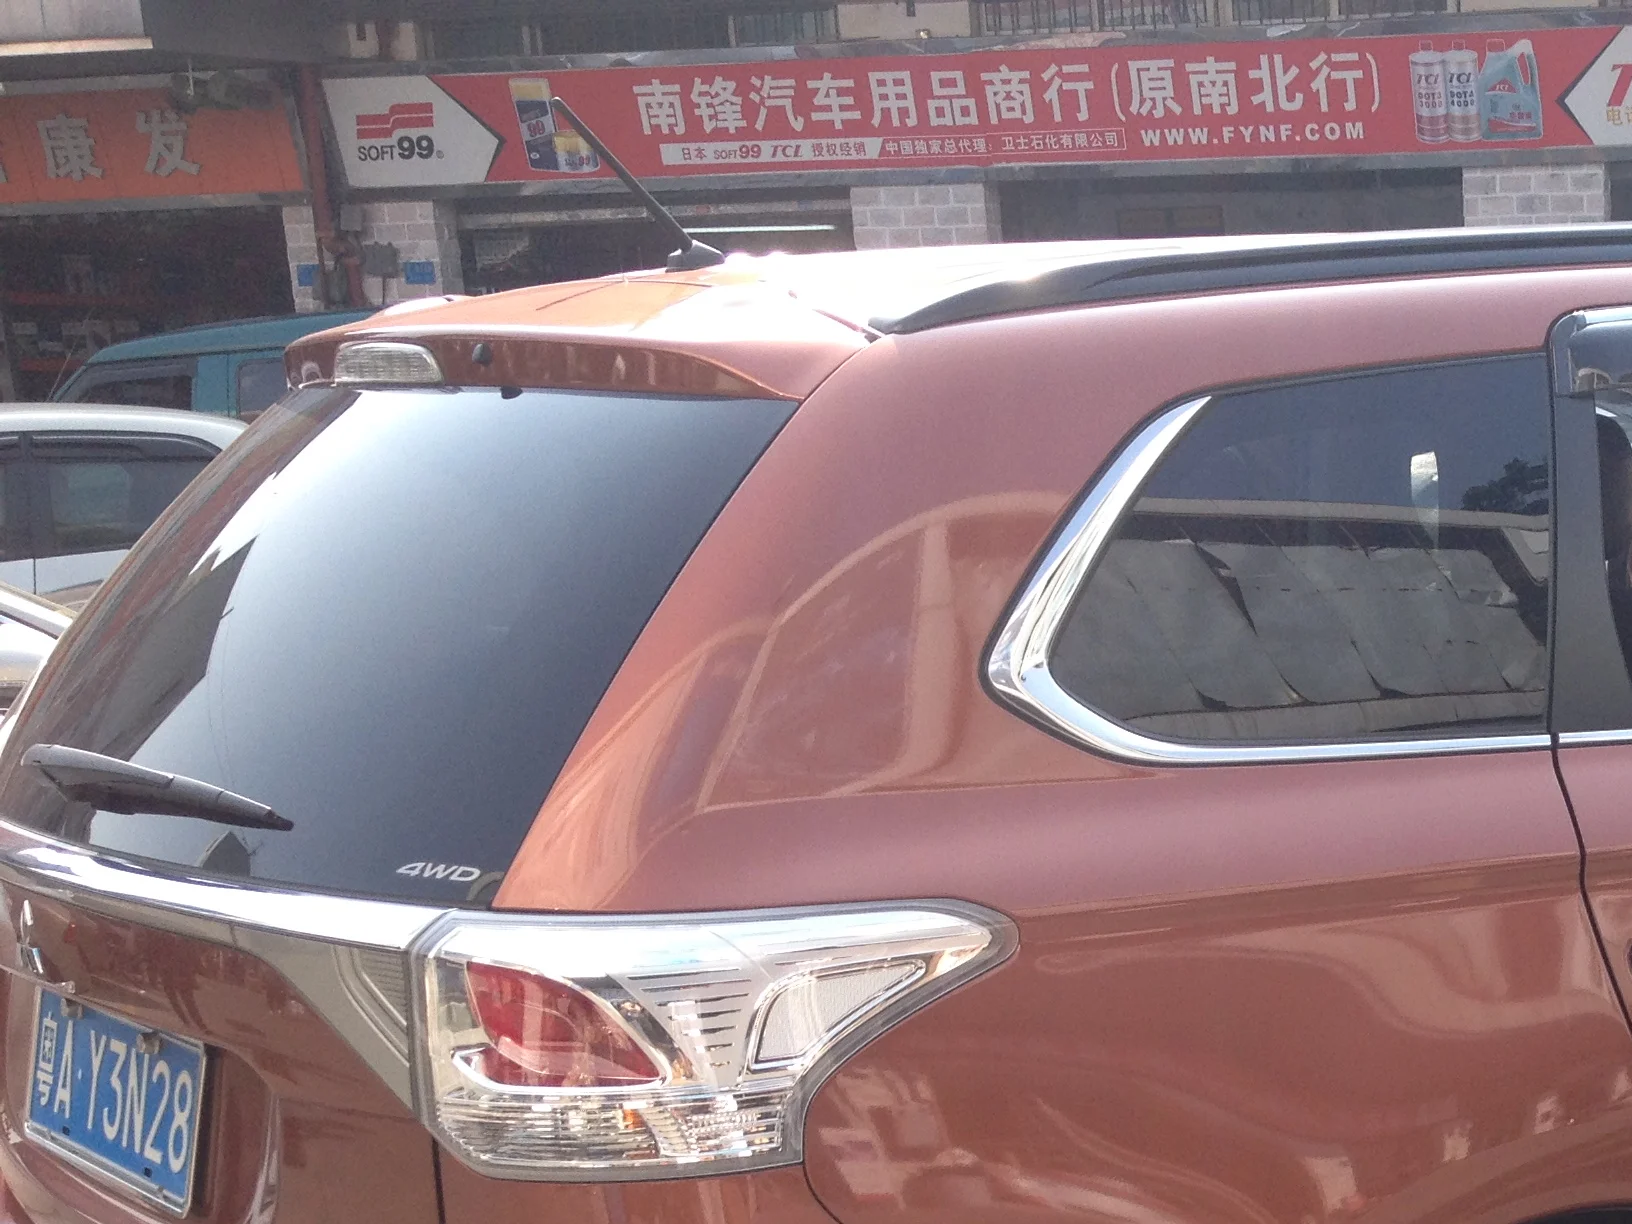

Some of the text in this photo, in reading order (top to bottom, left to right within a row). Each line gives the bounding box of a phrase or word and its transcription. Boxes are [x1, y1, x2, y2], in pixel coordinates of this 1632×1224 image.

[1002, 132, 1118, 151] 卫士石化有限公司
[1140, 121, 1365, 147] WWW.FYNF.COM
[0, 111, 201, 183] 康发
[357, 135, 435, 161] SOFT99
[681, 141, 867, 161] 日本 SOFT99 TCL 授权经销
[396, 862, 481, 881] 4WD
